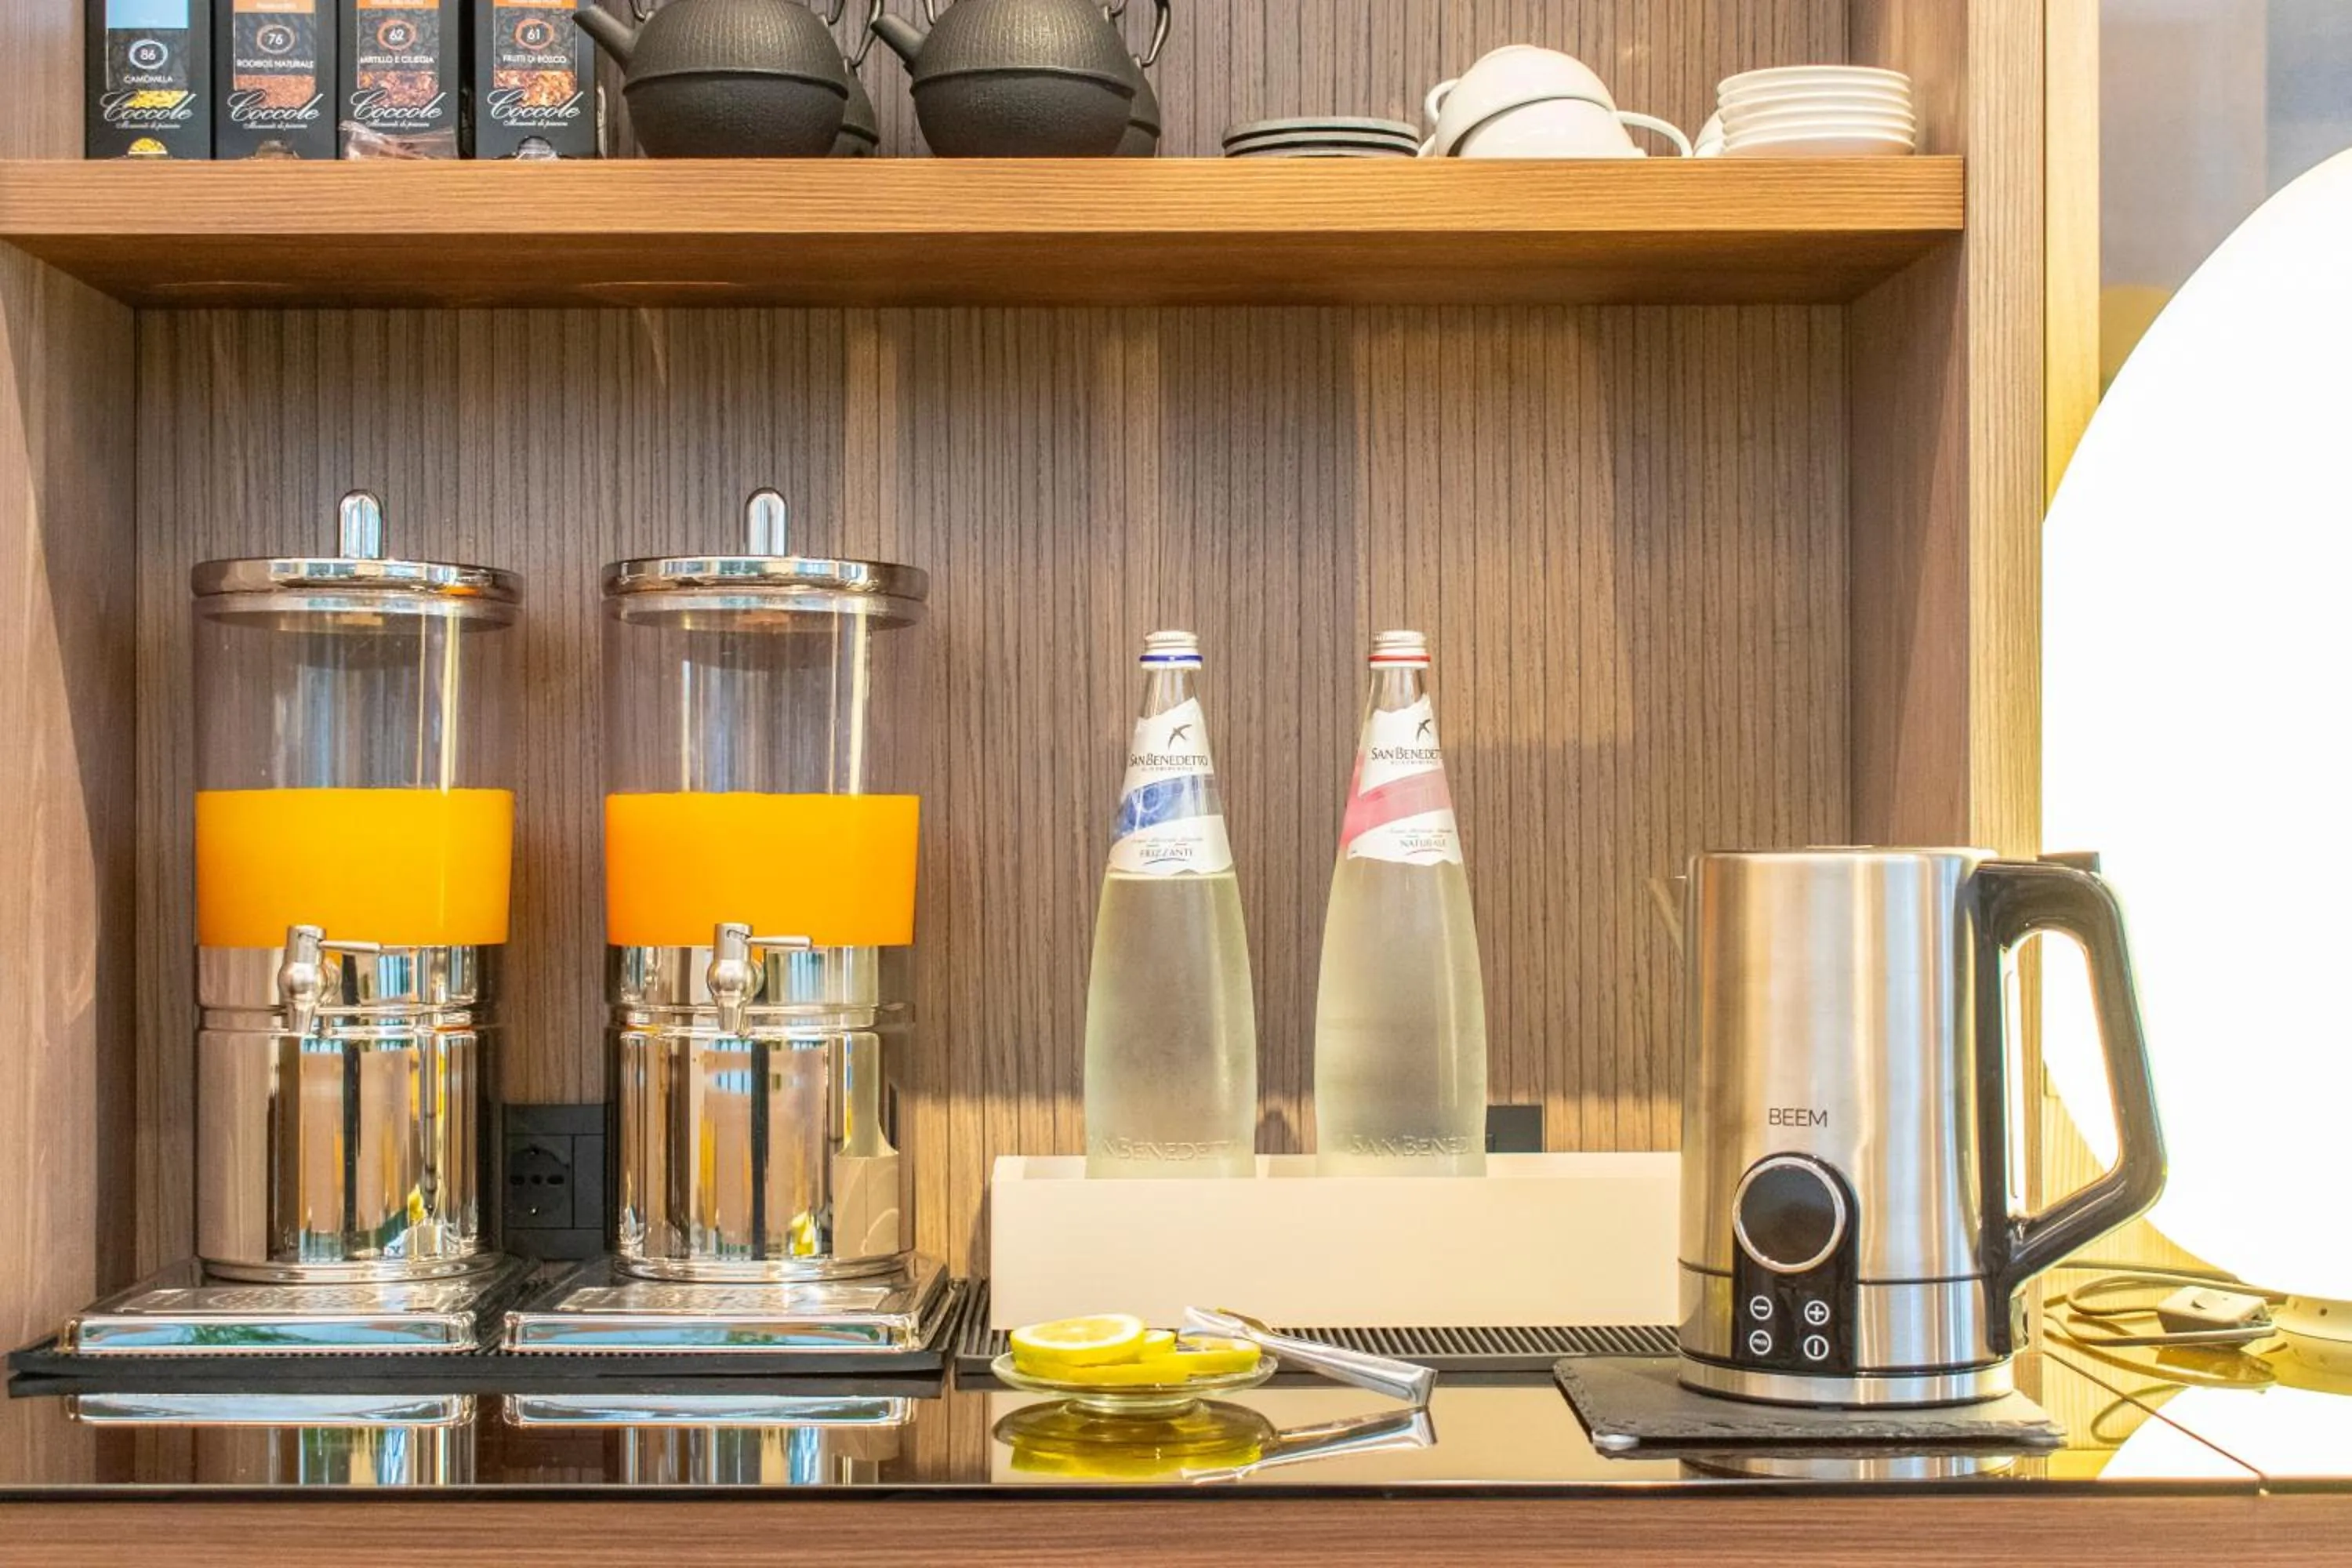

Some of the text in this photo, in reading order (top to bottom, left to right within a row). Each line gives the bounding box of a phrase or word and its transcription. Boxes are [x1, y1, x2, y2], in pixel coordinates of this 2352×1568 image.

[267, 33, 283, 45] 76
[388, 27, 405, 42] 62
[526, 28, 541, 41] 61
[140, 48, 156, 61] 86
[100, 89, 197, 122] Coccole
[227, 89, 324, 122] Coccole
[350, 89, 447, 120] Coccole
[487, 89, 584, 120] Coccole
[1769, 1108, 1828, 1127] BEEM
